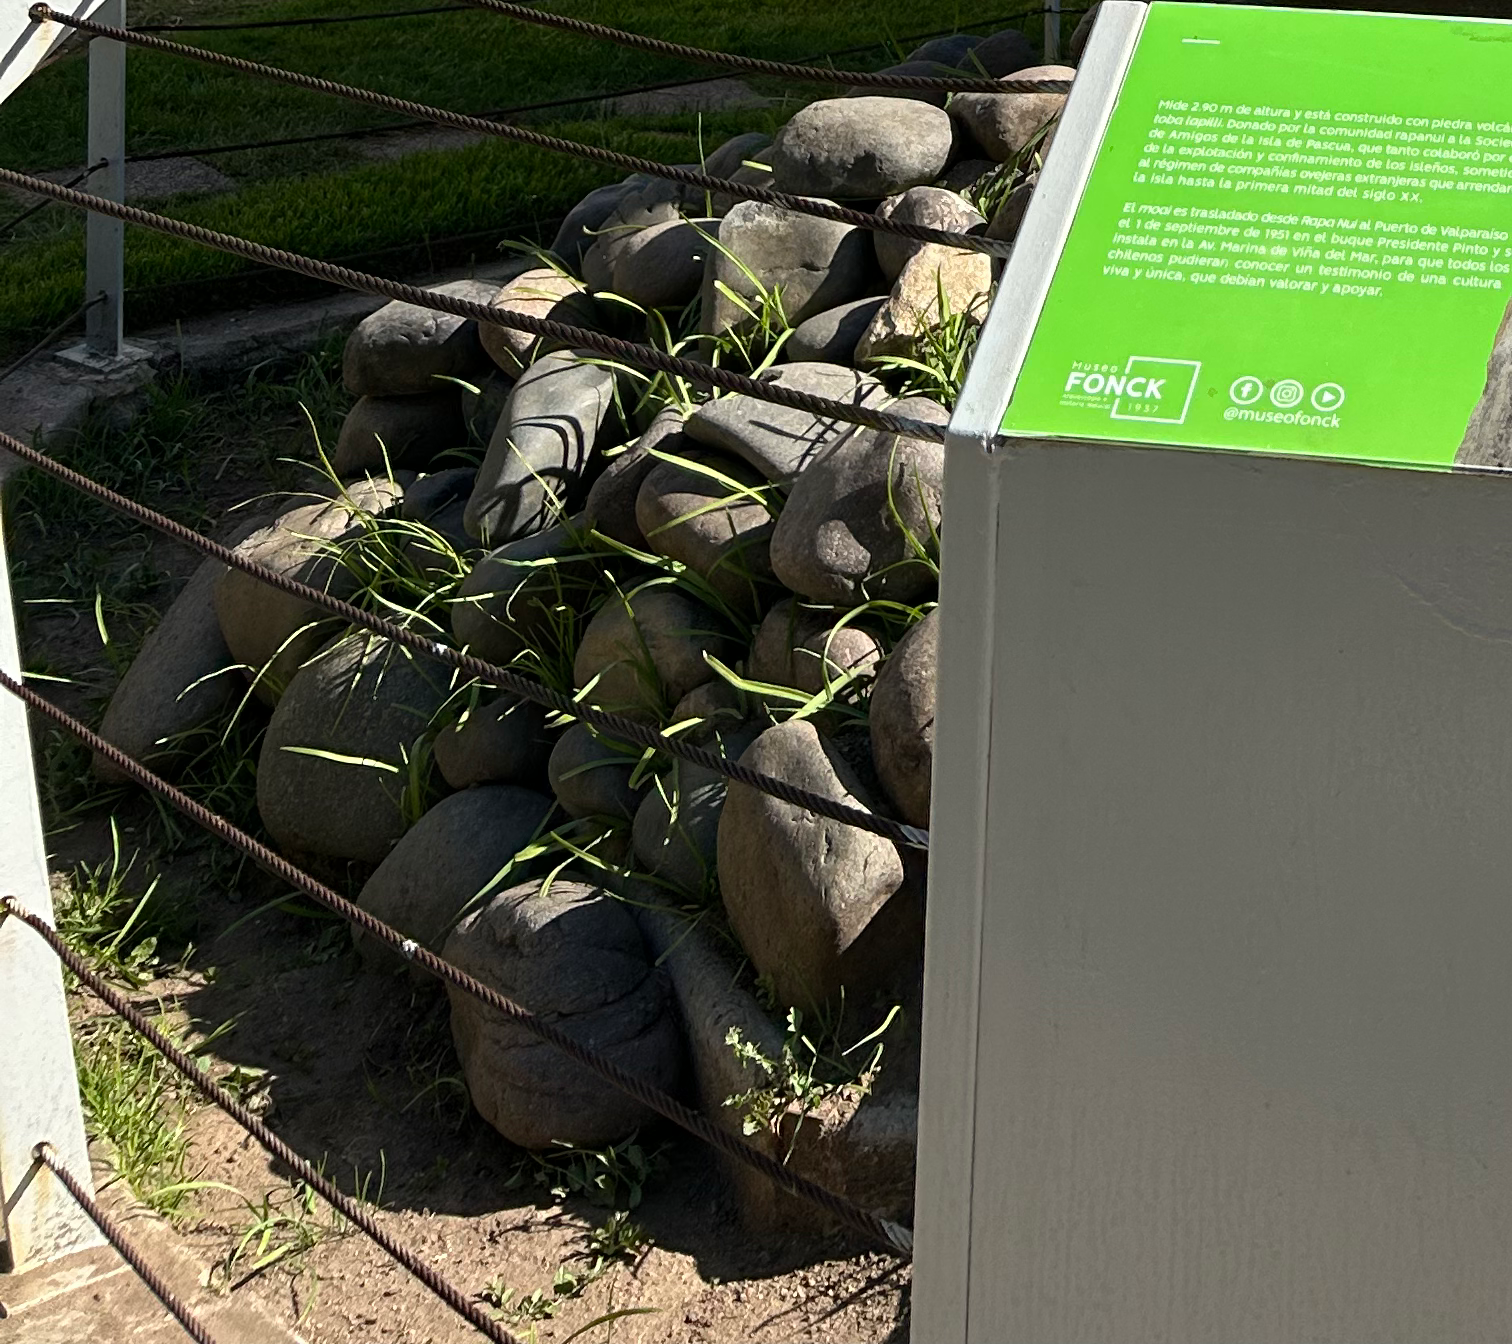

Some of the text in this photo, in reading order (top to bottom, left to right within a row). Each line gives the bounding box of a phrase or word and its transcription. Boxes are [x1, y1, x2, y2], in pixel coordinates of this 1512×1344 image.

[1153, 113, 1184, 125] toba
[1226, 119, 1276, 131] Donado
[1278, 123, 1302, 134] por
[1303, 123, 1316, 134] la
[1319, 126, 1393, 139] comunidad
[1395, 131, 1445, 143] rapanui
[1447, 135, 1456, 144] a
[1459, 134, 1471, 145] la
[1158, 99, 1189, 111] Mide
[1219, 104, 1234, 114] m
[1235, 104, 1252, 115] de
[1253, 105, 1291, 118] altura
[1293, 110, 1303, 120] y
[1303, 109, 1331, 121] está
[1334, 112, 1403, 126] construido
[1405, 117, 1430, 127] con
[1431, 118, 1473, 130] piedra
[1143, 142, 1160, 153] de
[1162, 143, 1175, 154] la
[1177, 147, 1253, 163] explotación
[1256, 152, 1265, 163] y
[1268, 152, 1362, 167] confinamiento
[1366, 158, 1382, 169] de
[1386, 159, 1406, 170] los
[1410, 161, 1458, 175] isleños,
[1148, 127, 1166, 139] de
[1168, 129, 1218, 144] Amigos
[1222, 133, 1239, 144] de
[1241, 134, 1254, 145] la
[1259, 136, 1281, 148] Isla
[1286, 138, 1303, 148] de
[1306, 139, 1354, 153] Pascua,
[1358, 144, 1382, 155] que
[1386, 144, 1420, 156] tanto
[1423, 148, 1480, 161] colaboró
[1483, 152, 1506, 163] por
[1133, 171, 1147, 184] la
[1150, 173, 1174, 185] isla
[1177, 174, 1215, 188] hasta
[1218, 177, 1232, 189] la
[1235, 180, 1290, 194] primera
[1293, 184, 1334, 197] mitad
[1336, 186, 1358, 200] del
[1362, 189, 1396, 202] siglo
[1138, 157, 1151, 168] al
[1154, 158, 1206, 174] régimen
[1209, 162, 1225, 173] de
[1300, 170, 1352, 182] ovejeras
[1355, 174, 1426, 188] extranjeras
[1429, 179, 1455, 191] que
[1117, 217, 1131, 229] el
[1136, 219, 1141, 229] 1
[1144, 219, 1161, 231] de
[1164, 222, 1240, 236] septiembre
[1243, 226, 1260, 238] de
[1266, 229, 1290, 240] 1951
[1293, 232, 1310, 242] en
[1314, 232, 1326, 243] el
[1331, 233, 1374, 247] buque
[1377, 237, 1449, 252] Presidente
[1452, 242, 1488, 255] Pinto
[1492, 247, 1501, 258] y
[1122, 202, 1509, 241] El moai es trasladado desde Rapa Nui al Puerto de Valparaíso
[1107, 248, 1502, 290] chilenos pudieran conocer un testimonio de una cultura
[1112, 232, 1157, 246] instala
[1161, 238, 1179, 248] en
[1181, 237, 1194, 249] la
[1220, 241, 1266, 255] Marina
[1270, 244, 1288, 257] de
[1292, 246, 1320, 259] Viña
[1325, 248, 1345, 261] del
[1381, 255, 1413, 266] para
[1418, 258, 1444, 270] que
[1448, 258, 1486, 272] todos
[1489, 257, 1510, 274] los
[1103, 264, 1130, 278] viva
[1132, 268, 1143, 280] y
[1190, 272, 1217, 285] que
[1269, 278, 1318, 291] valorar
[1320, 282, 1330, 296] y
[1072, 360, 1119, 374] Museo
[1064, 371, 1166, 400] FONCK
[1223, 406, 1341, 429] @museofonck
